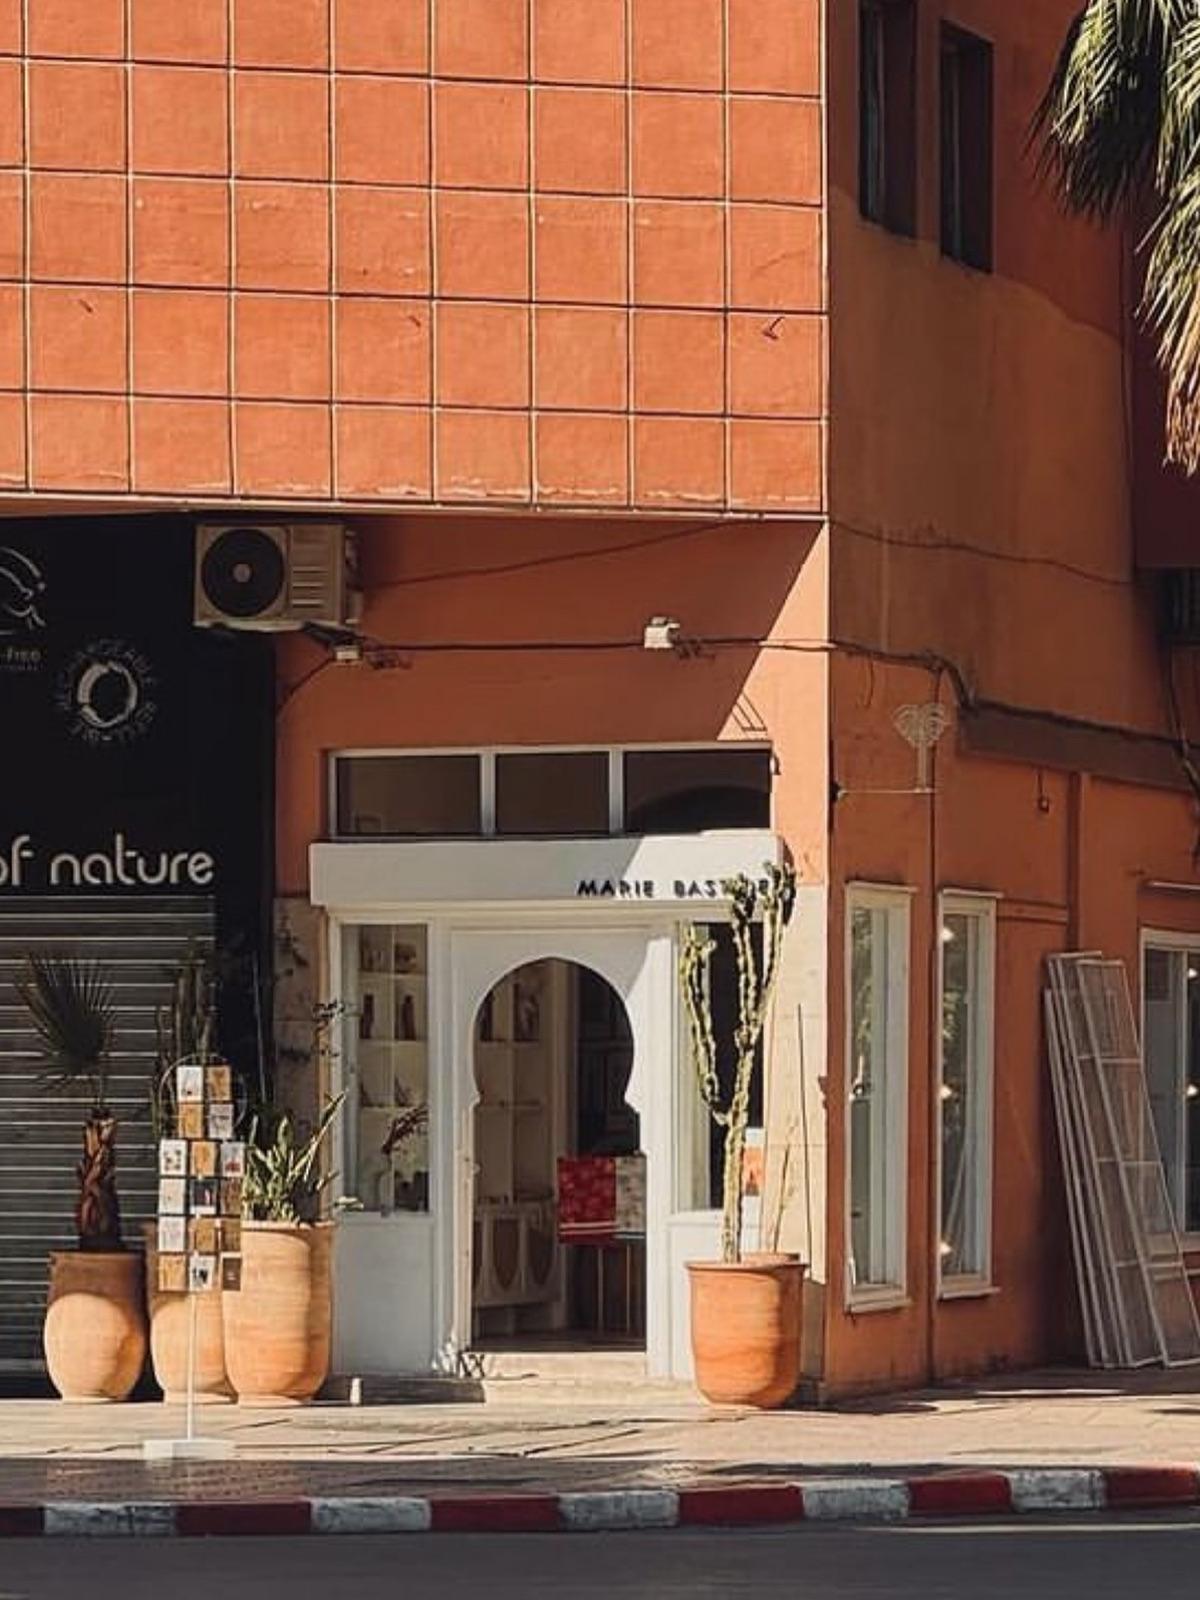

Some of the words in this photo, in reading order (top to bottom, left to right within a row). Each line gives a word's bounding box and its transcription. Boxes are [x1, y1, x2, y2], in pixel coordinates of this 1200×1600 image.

[0, 834, 34, 886] f
[50, 833, 215, 885] nature
[577, 880, 654, 897] MARIE
